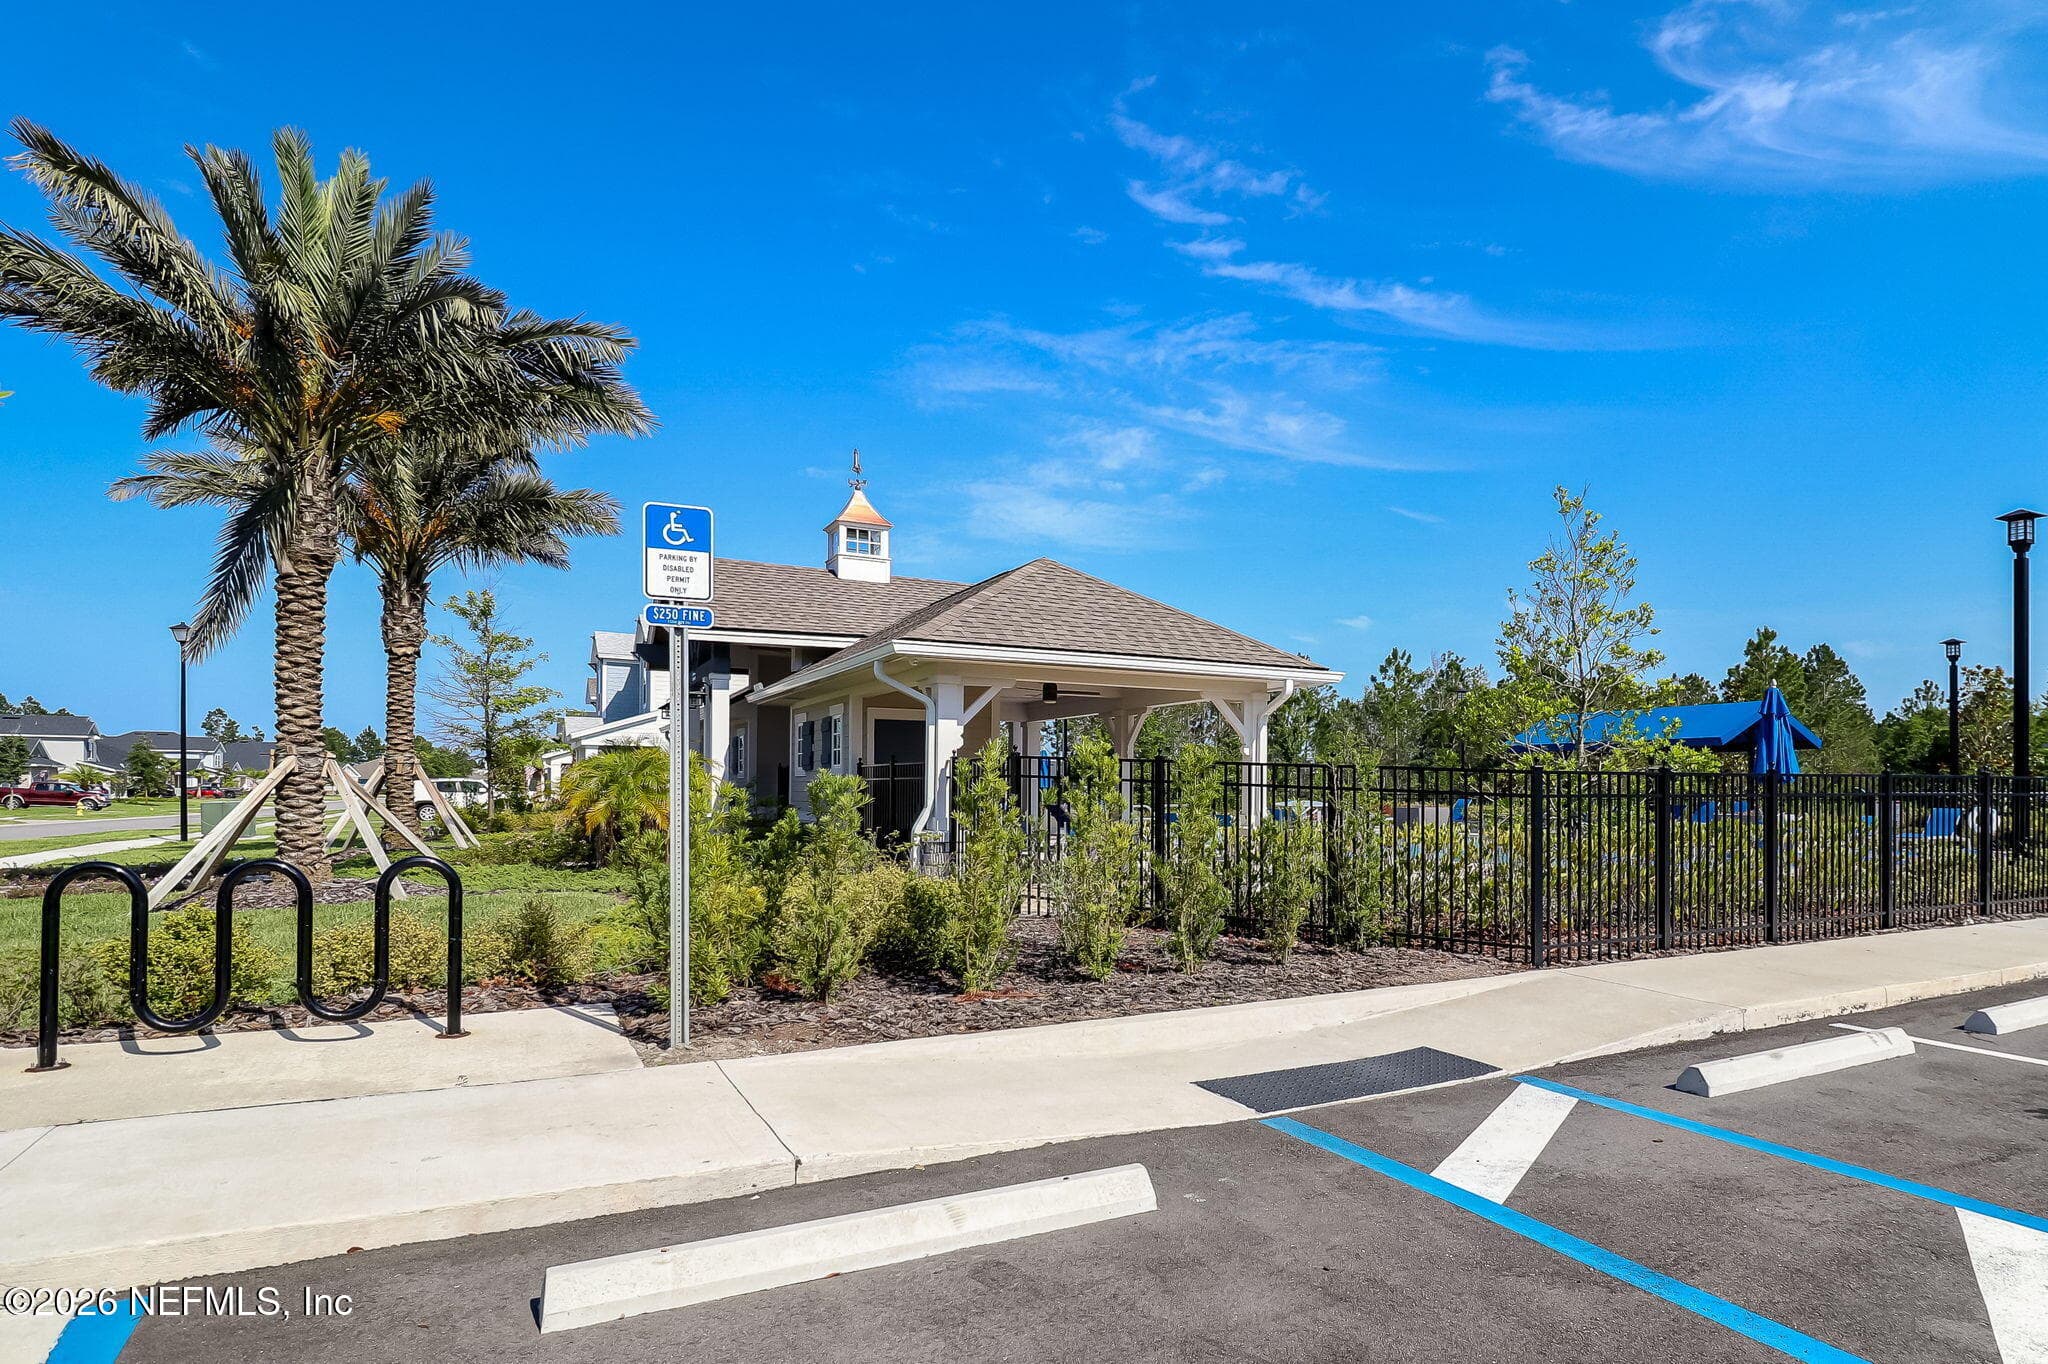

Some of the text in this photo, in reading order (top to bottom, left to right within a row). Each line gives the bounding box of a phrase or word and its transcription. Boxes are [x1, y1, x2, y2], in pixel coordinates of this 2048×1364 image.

[659, 553, 698, 563] PARKING BY
[662, 564, 694, 573] DISABLED
[666, 575, 690, 584] PERMIT
[669, 586, 687, 594] ONLY
[653, 607, 678, 620] $250
[682, 609, 706, 622] FINE
